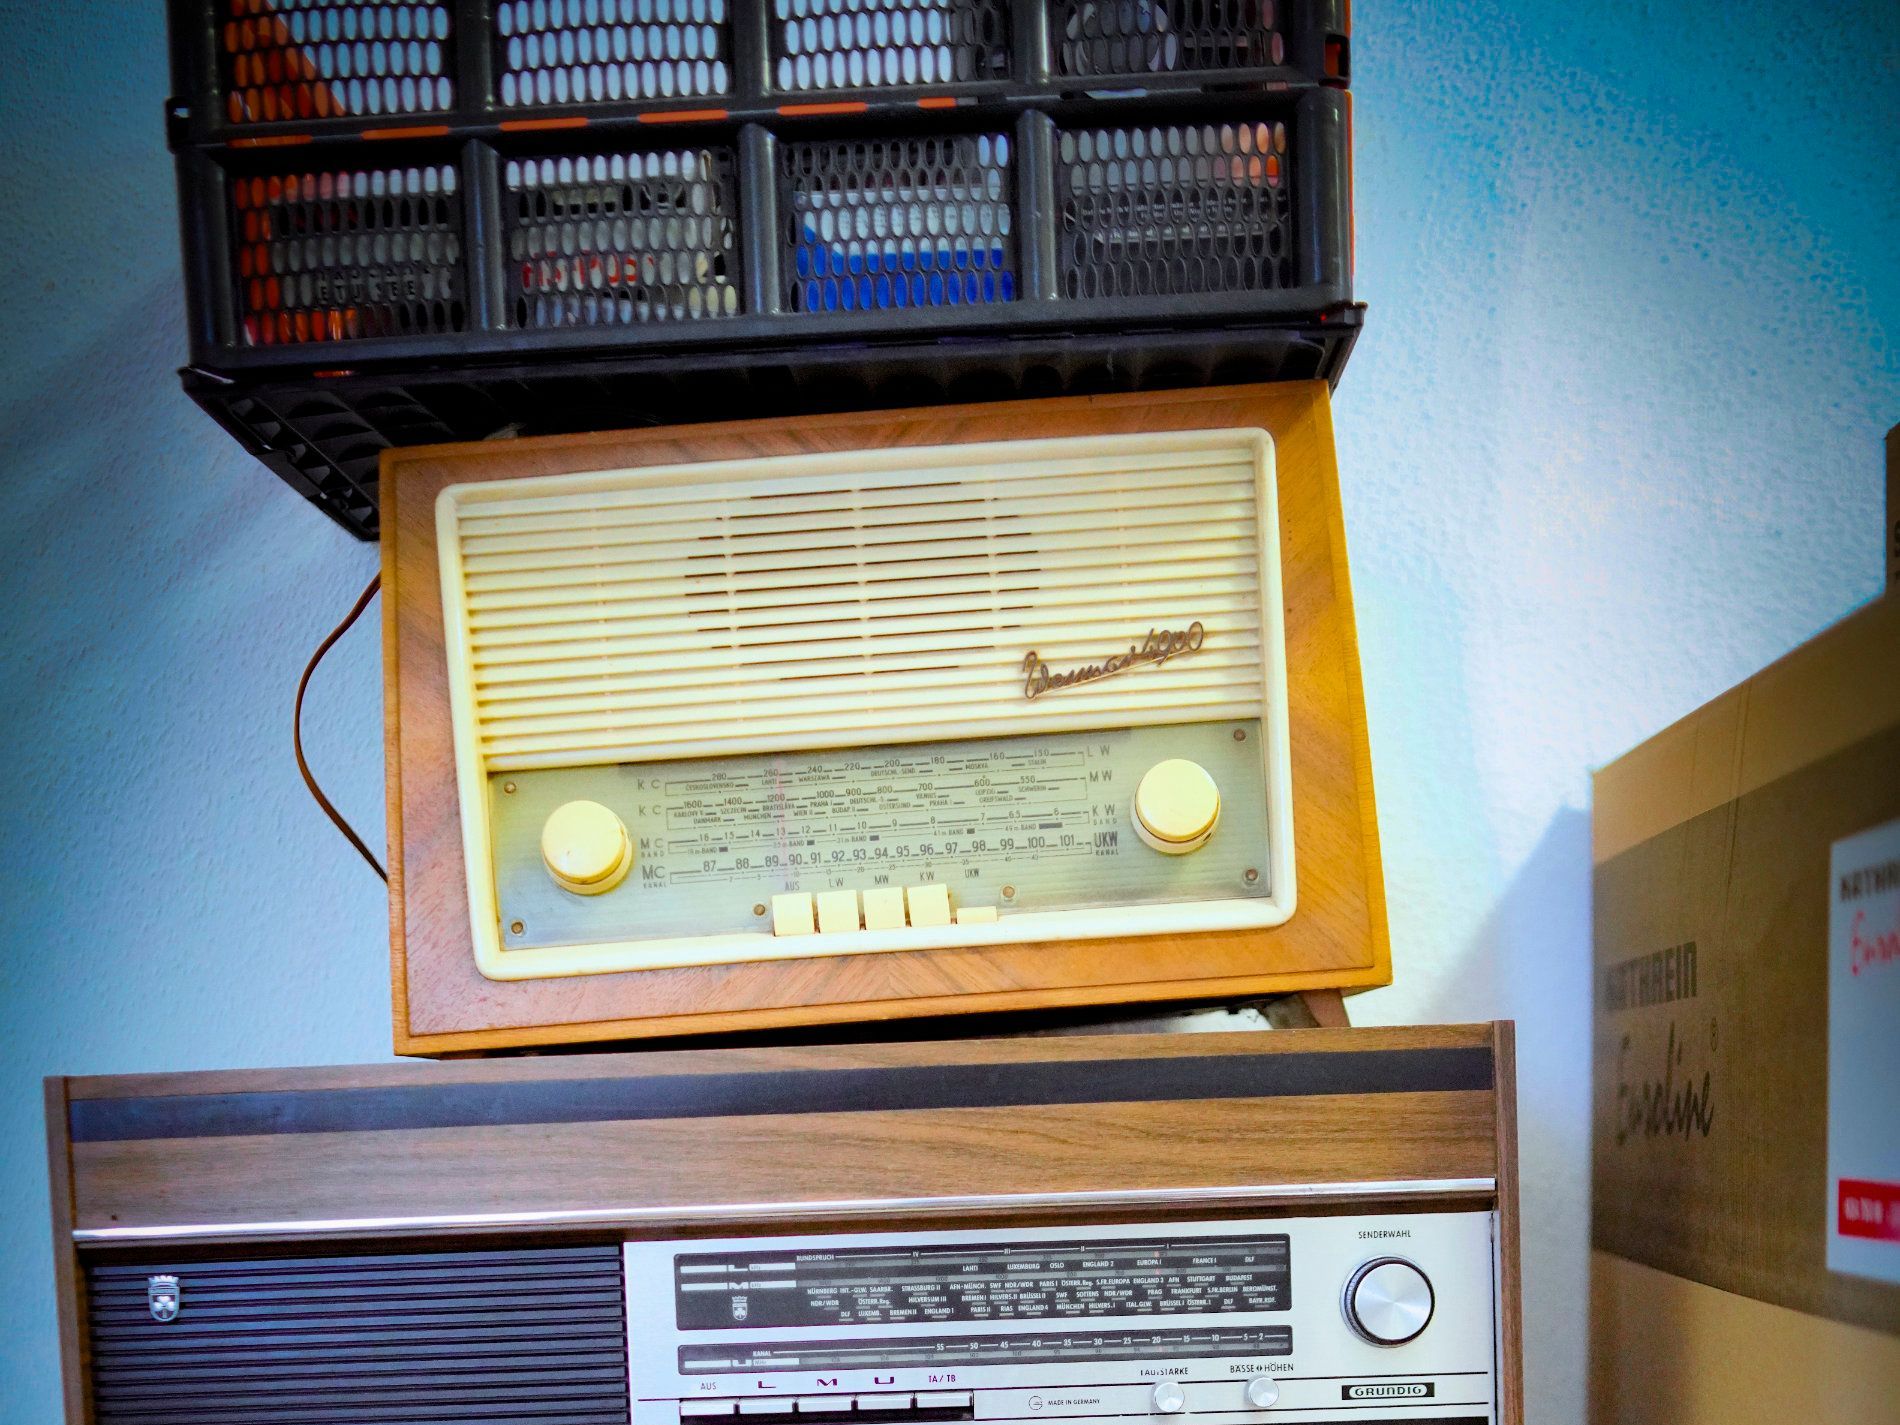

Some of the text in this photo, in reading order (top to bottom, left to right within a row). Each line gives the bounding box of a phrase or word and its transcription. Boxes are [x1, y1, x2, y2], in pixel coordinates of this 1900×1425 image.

[807, 765, 823, 774] 240
[844, 762, 861, 771] 220
[884, 759, 901, 768] 200
[930, 756, 946, 765] 180
[767, 794, 786, 802] 1200
[816, 790, 835, 799] 1000
[845, 788, 862, 797] 900
[876, 785, 893, 794] 800
[916, 783, 933, 792] 700
[974, 778, 991, 788] 600
[1020, 775, 1036, 784] 550
[642, 830, 1118, 881] MC 87 88 89 90 91 92 93 94 95 96 97 98 99 100 101 UKW
[784, 881, 801, 892] AUS
[874, 874, 890, 885] MW
[964, 867, 980, 878] UKW
[1602, 941, 1698, 1012] THREIN
[1357, 1229, 1412, 1240] SENDERWAHL
[1007, 1262, 1041, 1271] LUXEMBURG
[1082, 1260, 1108, 1268] ENGLAND
[1136, 1258, 1158, 1267] EUROPA
[962, 1264, 979, 1272] LAHTI
[1133, 1277, 1160, 1285] ENGLAND
[1168, 1276, 1180, 1284] AFN
[901, 1284, 936, 1292] STRASSBURG
[1004, 1281, 1034, 1290] NDR/WDR
[807, 1286, 838, 1295] NÜRNBERG
[1055, 1291, 1068, 1299] SWF
[1170, 1287, 1203, 1295] FRANKFURT
[1056, 1301, 1085, 1311] MÜNCHEN
[924, 1307, 950, 1315] ENGLAND
[969, 1342, 979, 1350] 50
[999, 1340, 1009, 1350] 45
[1031, 1339, 1042, 1348] 40
[1062, 1338, 1072, 1347] 35
[1093, 1337, 1103, 1346] 30
[1122, 1336, 1132, 1345] 25
[1151, 1335, 1162, 1344] 20
[1182, 1334, 1191, 1343] 15
[1210, 1334, 1220, 1342] 10
[752, 1350, 772, 1358] KANAL
[1264, 1362, 1294, 1373] HÖHEN
[700, 1380, 718, 1391] AUS
[816, 1378, 838, 1387] M
[1354, 1385, 1423, 1397] GRUNDIG
[1073, 1397, 1101, 1405] GERMANY
